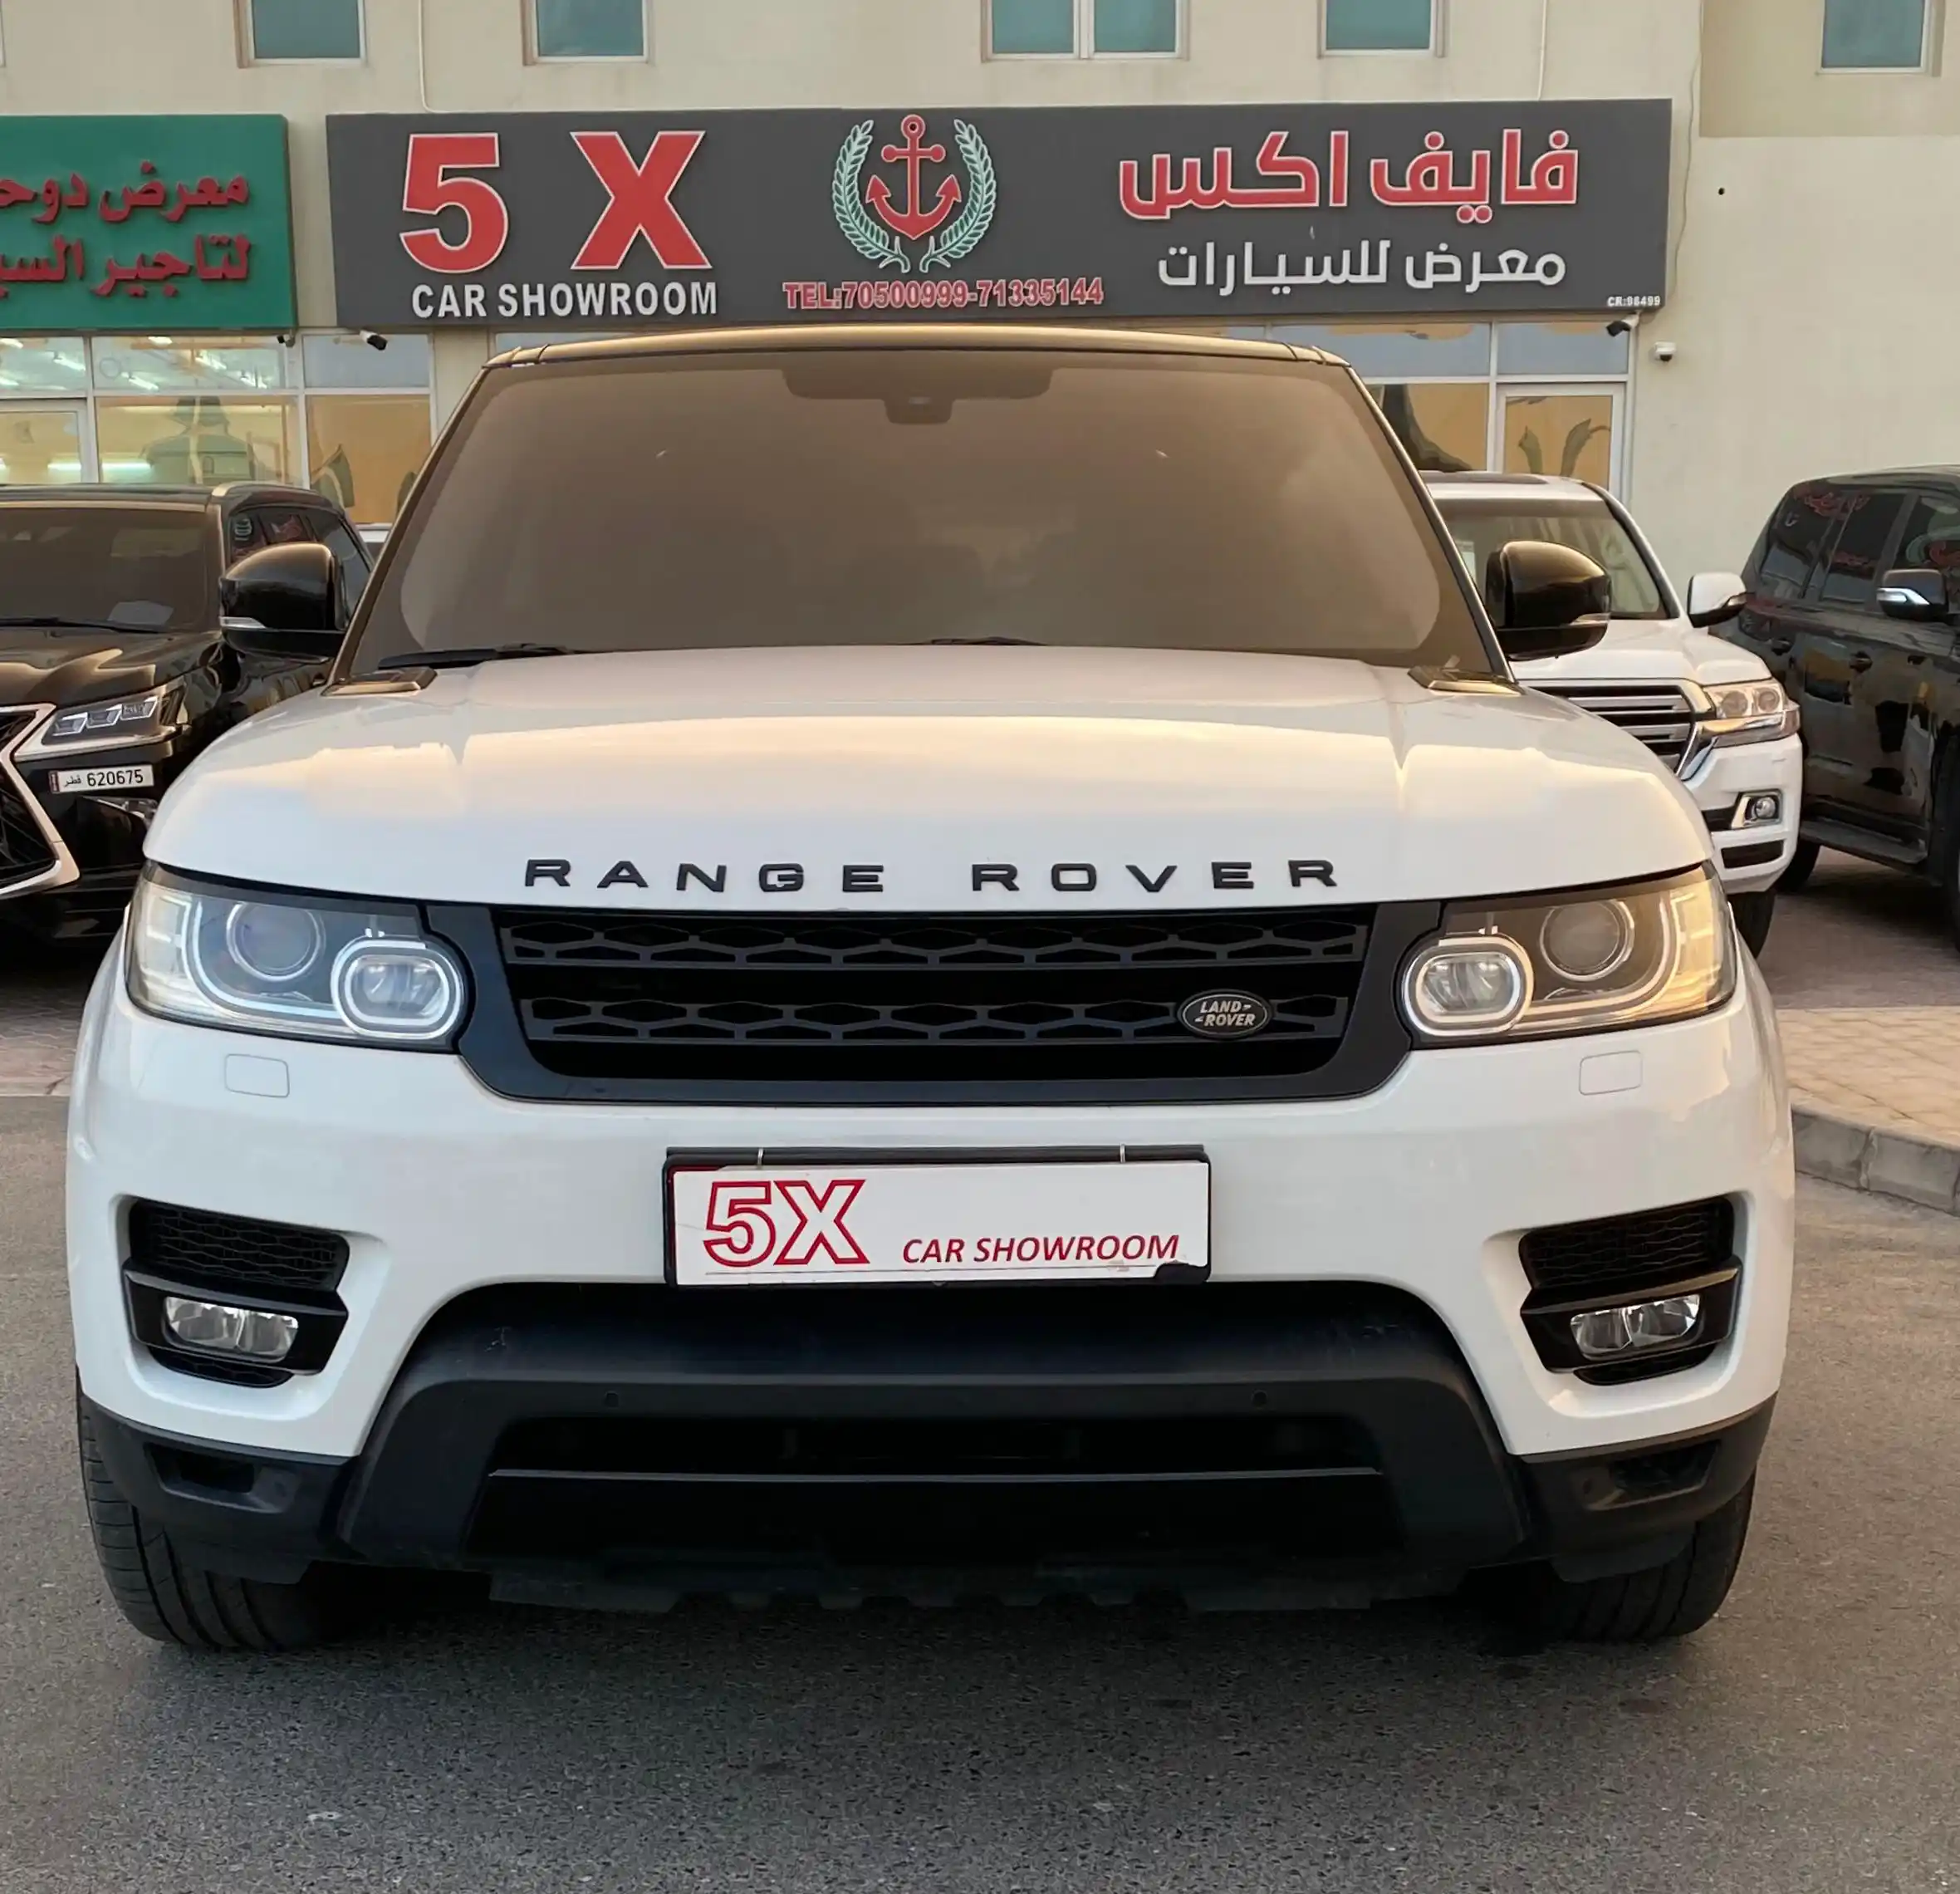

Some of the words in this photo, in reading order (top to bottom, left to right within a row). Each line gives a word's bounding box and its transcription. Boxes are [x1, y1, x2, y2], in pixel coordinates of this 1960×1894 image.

[99, 159, 250, 223] معرض
[399, 132, 509, 274] 5
[569, 130, 713, 271] X
[1119, 130, 1349, 221] اكس
[1370, 128, 1579, 224] فايف
[89, 233, 251, 297] لتاجير
[1158, 238, 1391, 297] للسيارات
[1405, 243, 1567, 294] معرض
[412, 284, 487, 319] CAR
[498, 281, 718, 317] SHOWROOM
[86, 768, 144, 787] 620675
[524, 858, 884, 893] RANGE
[971, 859, 1338, 893] ROVER
[1199, 1000, 1242, 1013] LAND
[1203, 1013, 1256, 1027] ROVER
[703, 1180, 870, 1268] 5X
[902, 1237, 964, 1264] CAR
[973, 1234, 1180, 1263] SHOWROOM
